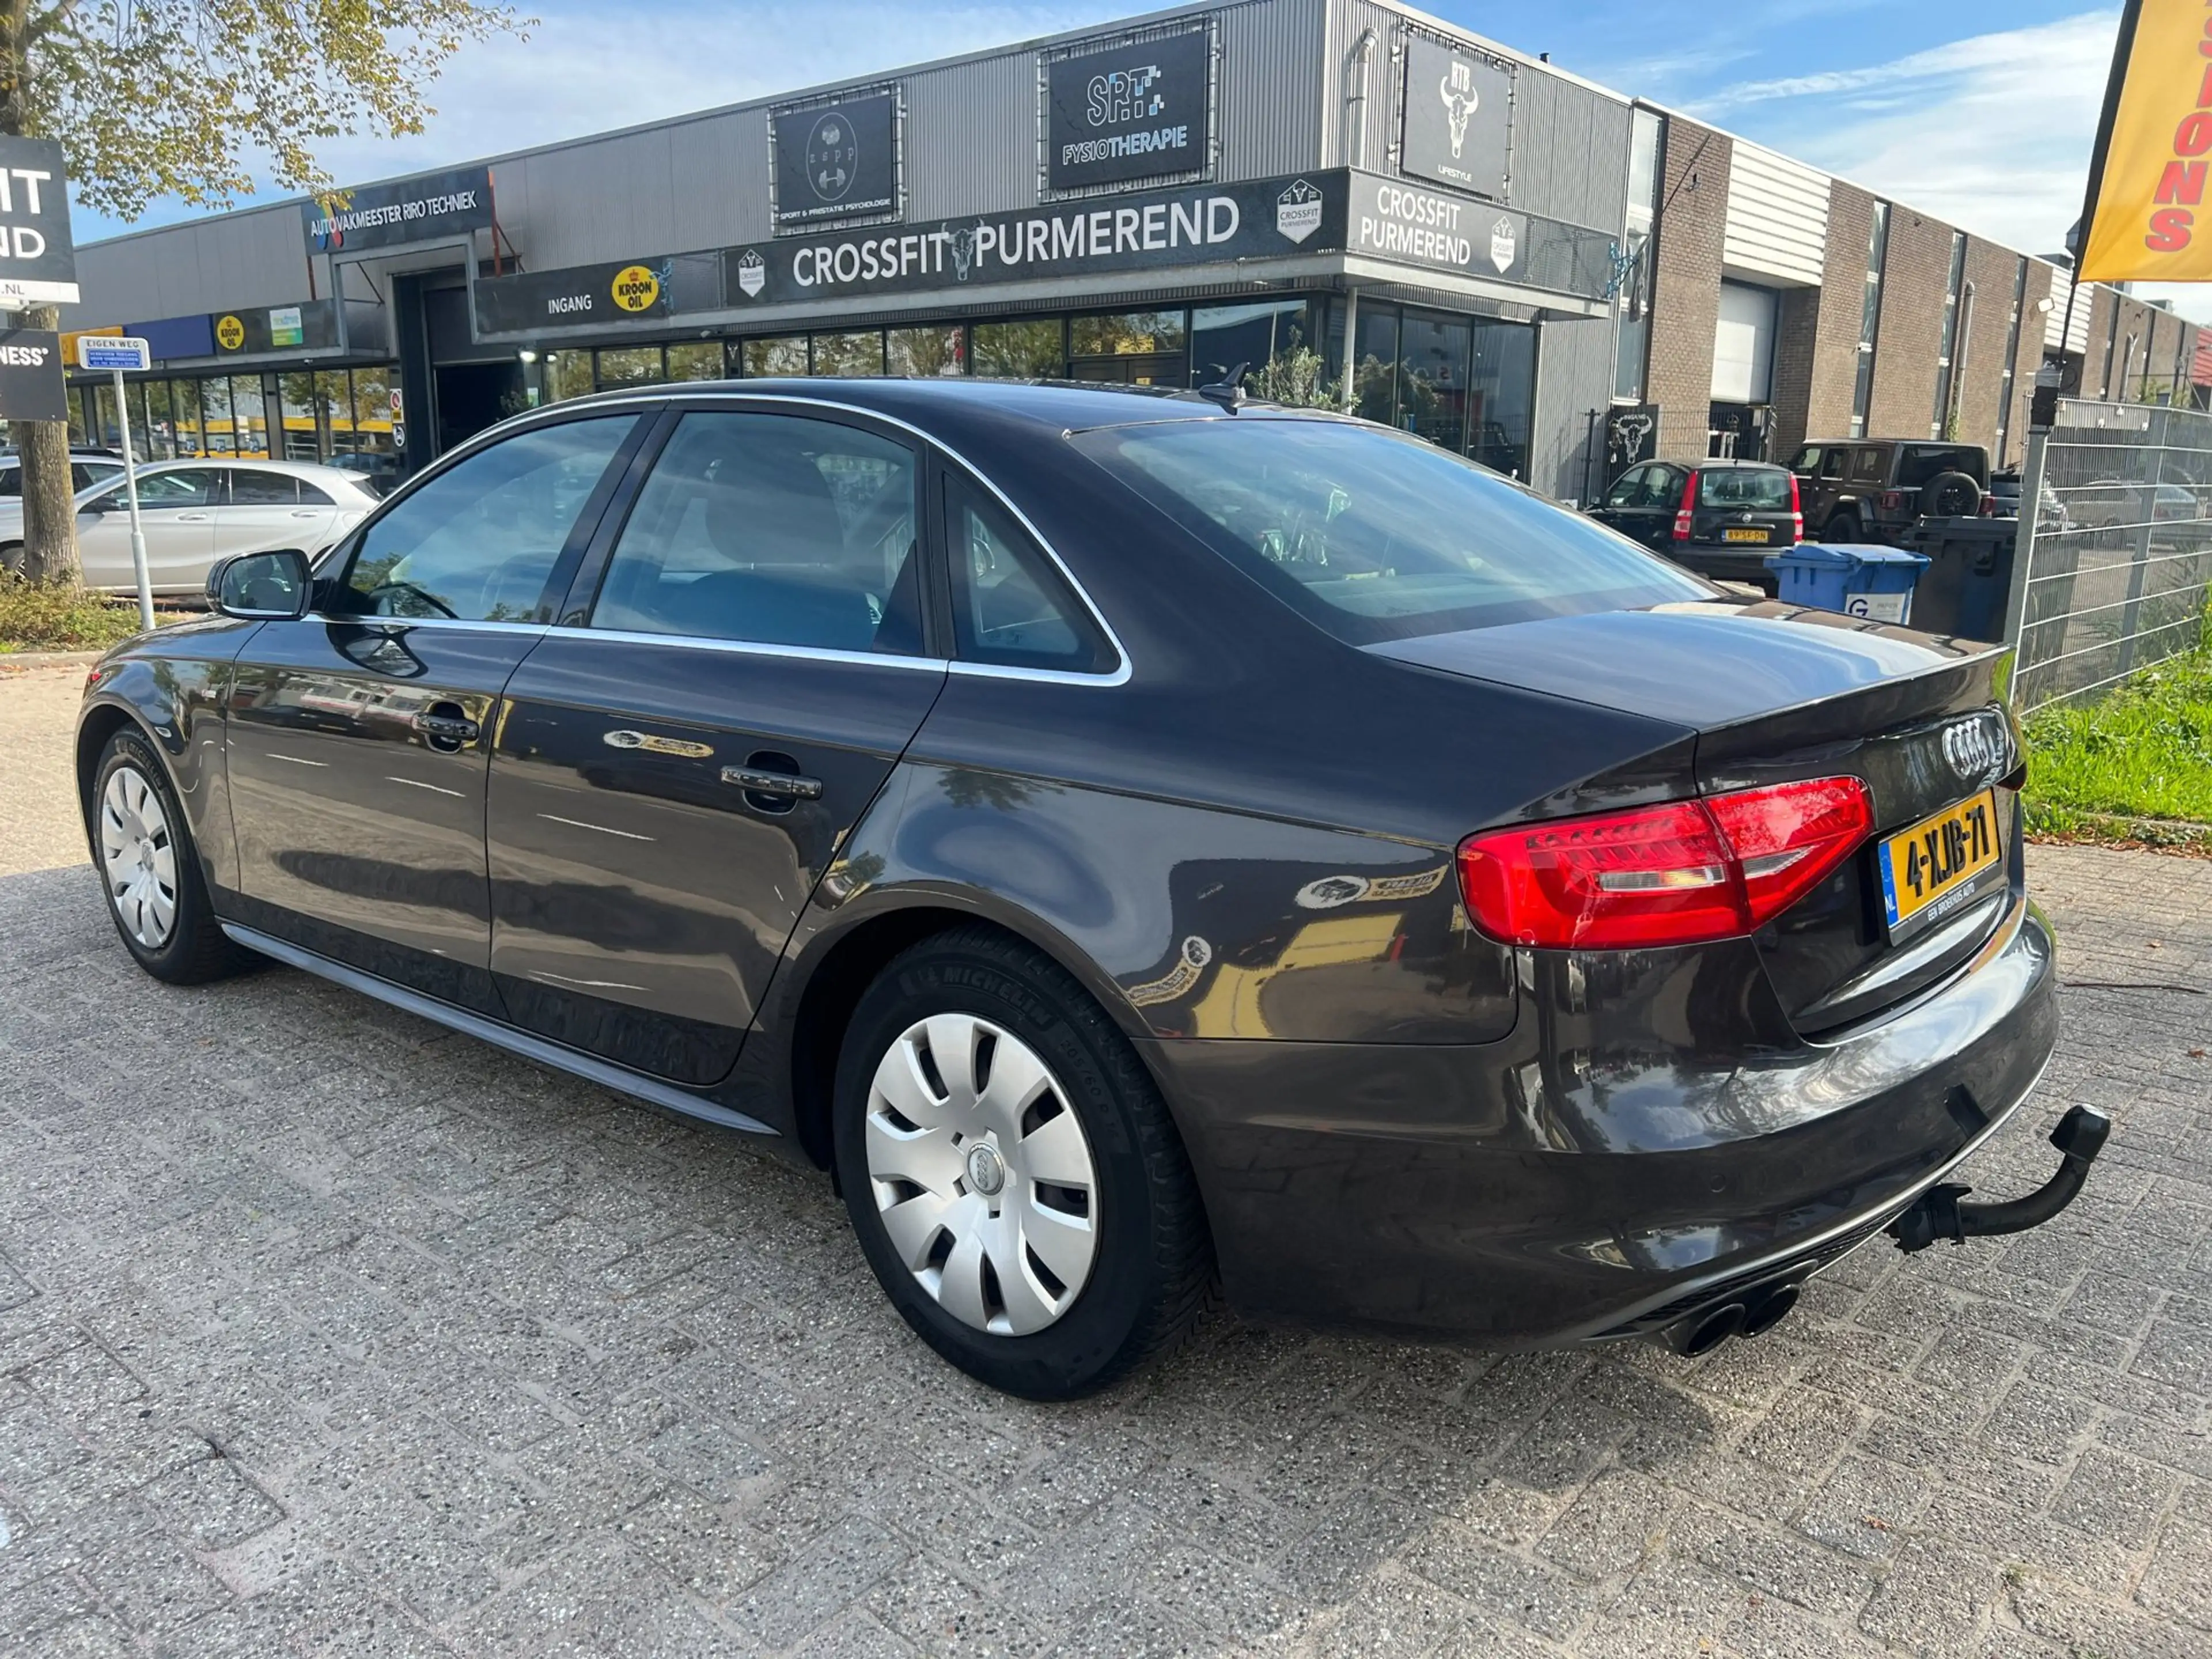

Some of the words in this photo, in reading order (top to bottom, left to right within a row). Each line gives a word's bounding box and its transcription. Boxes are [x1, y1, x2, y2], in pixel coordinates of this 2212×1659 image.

[1451, 61, 1470, 92] RTB
[1062, 125, 1187, 166] FYSIOTHERAPIE
[1438, 164, 1472, 182] LIFESTYLE
[310, 207, 403, 236] AUTOVAKMEESTER
[403, 200, 426, 221] RIRO
[427, 190, 477, 215] TECHNIEK
[780, 211, 801, 219] SPORT
[809, 205, 844, 215] PRESTATIE
[845, 198, 891, 211] PSYCHOLOGIE
[1280, 208, 1319, 221] CROSSFIT
[1377, 185, 1461, 230] CROSSFIT
[793, 232, 949, 287] CROSSFIT
[976, 196, 1240, 268] PURMEREND
[1361, 217, 1471, 265] PURMEREND
[548, 294, 592, 314] INGANG
[618, 281, 652, 297] KROON
[628, 296, 643, 308] OIL
[1907, 805, 1990, 897] 4-XJB-71
[1885, 894, 1896, 914] NL
[943, 967, 1054, 1027] MICHELIN
